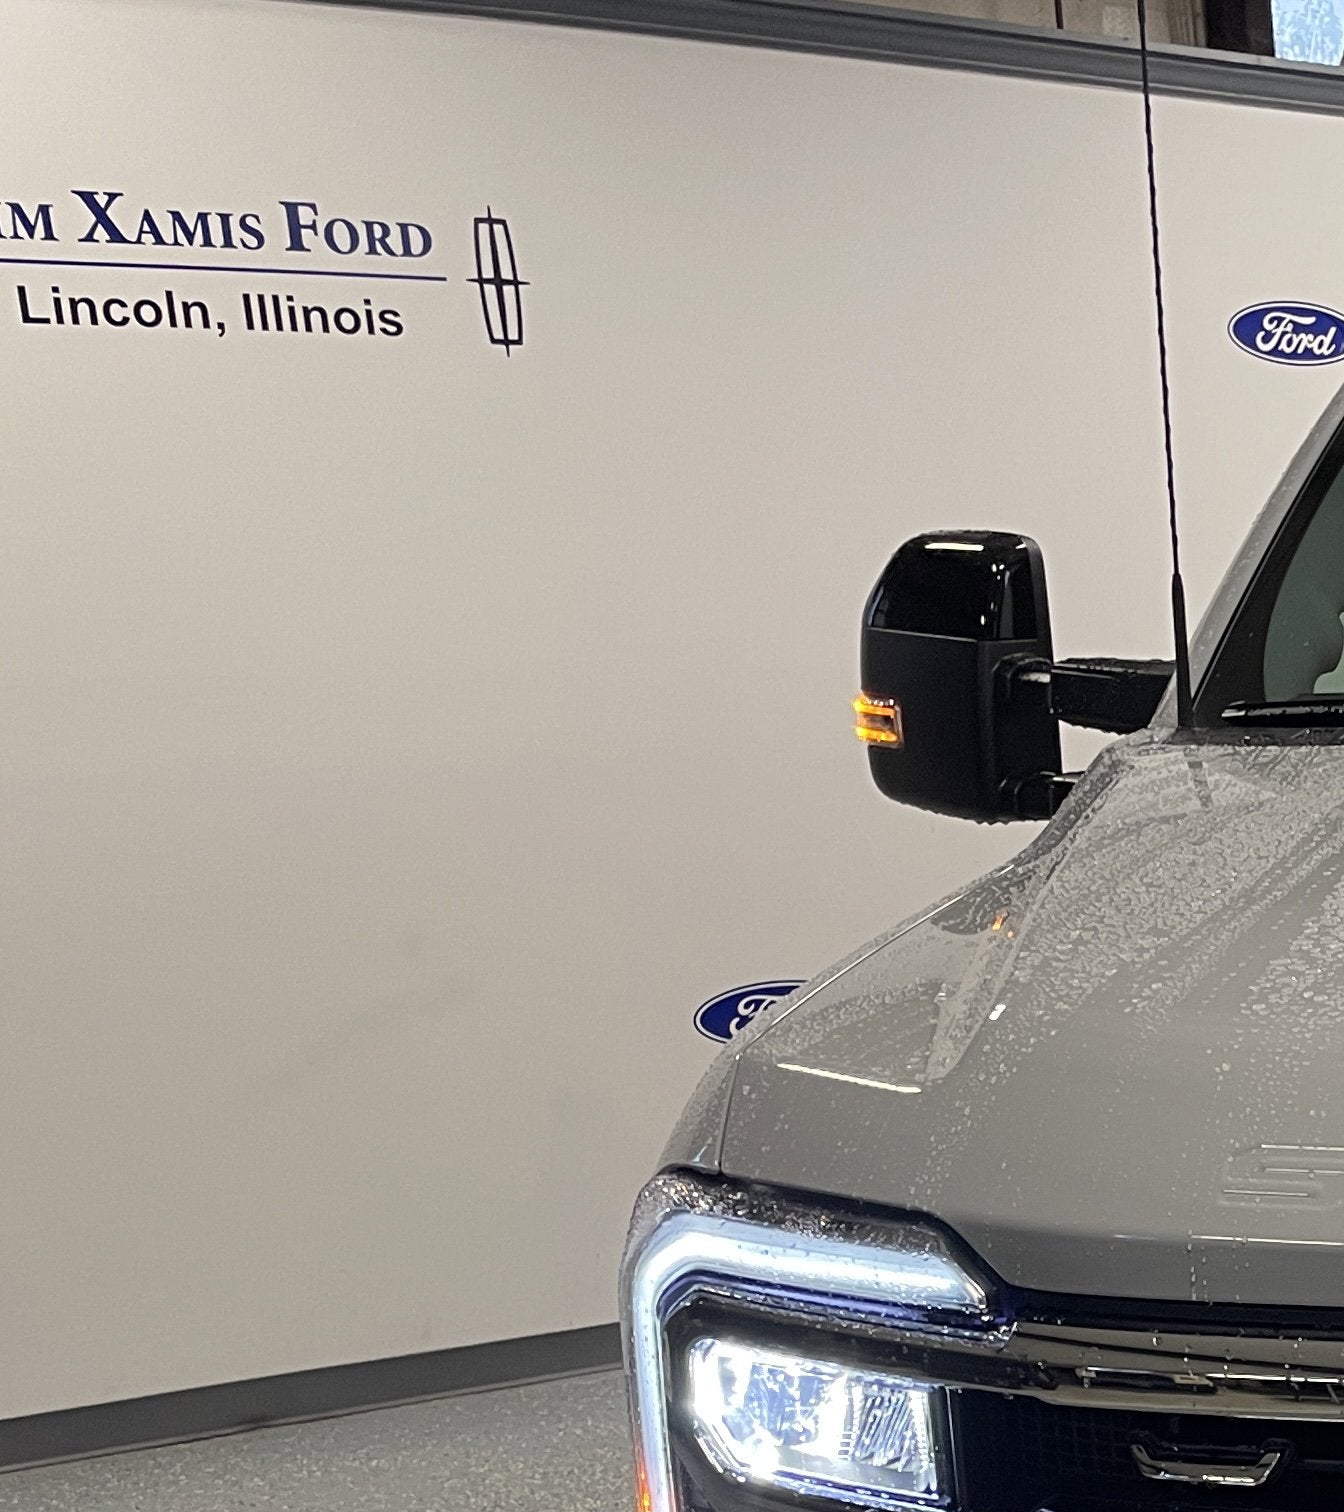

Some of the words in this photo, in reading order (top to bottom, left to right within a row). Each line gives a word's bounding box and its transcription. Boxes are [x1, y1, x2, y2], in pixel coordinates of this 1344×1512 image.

[70, 189, 267, 252] XAMIS
[278, 200, 433, 258] FORD
[16, 285, 227, 337] Lincoln,
[242, 292, 404, 336] Illinois
[1255, 311, 1337, 356] Ford
